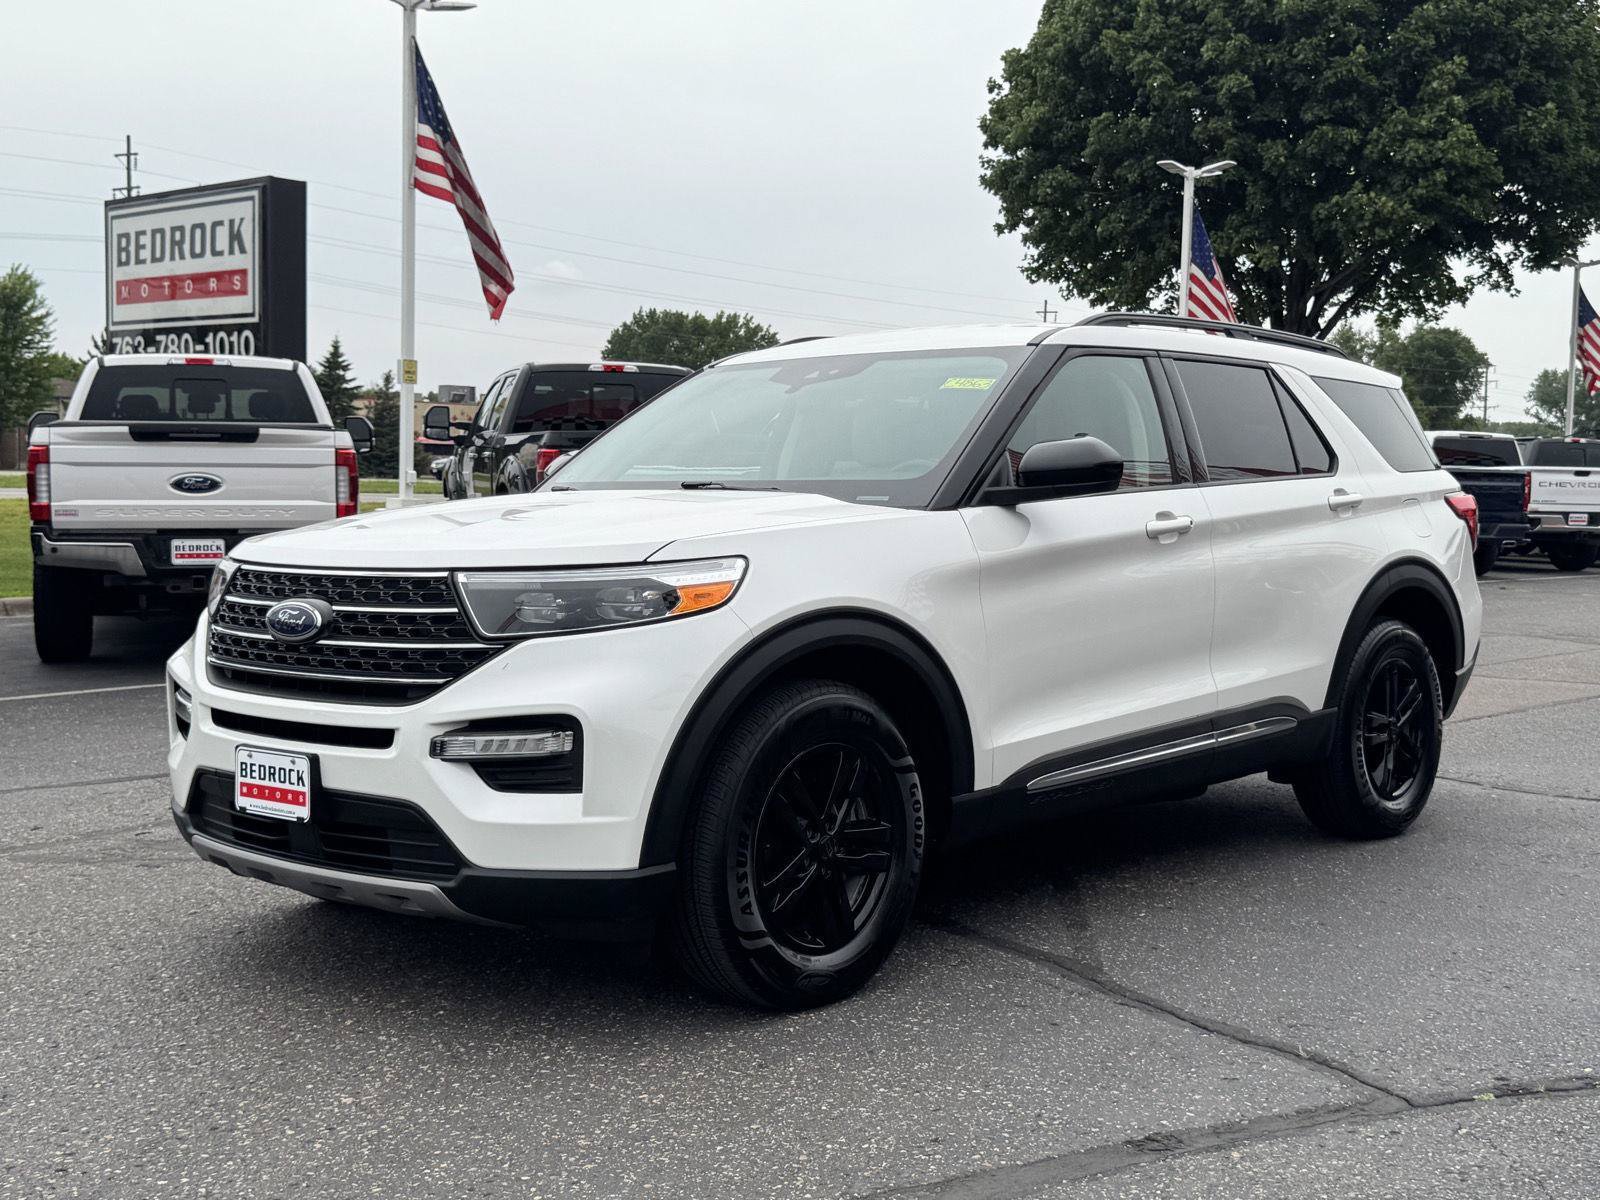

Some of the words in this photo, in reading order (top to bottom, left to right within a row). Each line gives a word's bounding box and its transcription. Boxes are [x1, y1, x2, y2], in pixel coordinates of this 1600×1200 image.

[116, 217, 248, 268] BEDROCK
[121, 276, 242, 299] MOTORS
[112, 330, 255, 355] 763-780-1010
[183, 477, 211, 489] Ford
[96, 508, 205, 517] SUPER
[214, 508, 296, 517] DUTY
[175, 544, 222, 552] BEDROCK
[276, 609, 306, 630] Ford
[239, 761, 306, 788] BEDROCK
[242, 785, 304, 803] MOTORS
